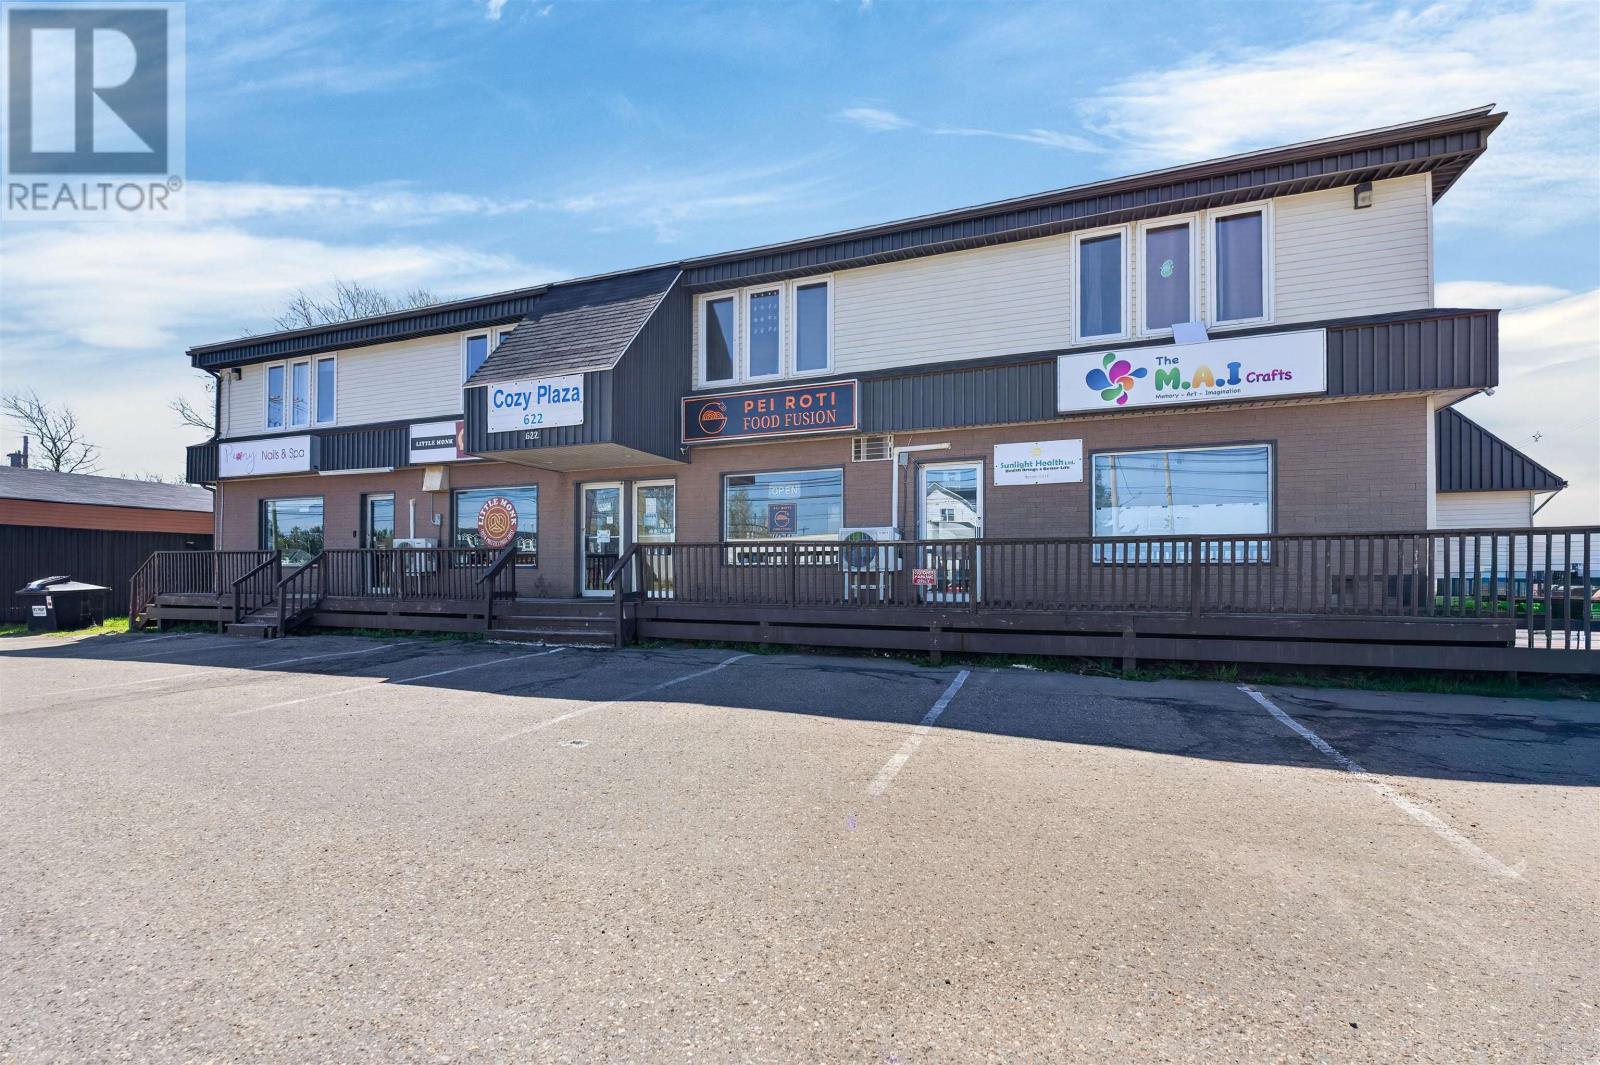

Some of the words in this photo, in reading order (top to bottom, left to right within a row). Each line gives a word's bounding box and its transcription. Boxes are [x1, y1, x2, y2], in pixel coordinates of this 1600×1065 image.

[1156, 356, 1179, 366] The
[1155, 361, 1242, 391] M.A.I
[1246, 369, 1293, 383] Crafts
[493, 389, 532, 410] Cozy
[537, 385, 580, 404] Plaza
[1205, 388, 1242, 396] Imagination
[744, 398, 775, 413] PEI
[785, 392, 836, 409] ROTI
[523, 413, 544, 425] 622
[743, 415, 780, 431] FOOD
[784, 410, 837, 427] FUSION
[261, 450, 280, 461] Nails
[281, 448, 288, 459] &
[289, 447, 305, 459] Spa
[1000, 460, 1033, 469] Sunlight
[1035, 458, 1063, 467] Health
[771, 485, 798, 495] OPEN
[478, 498, 499, 525] LITTLE
[500, 498, 517, 525] MONK
